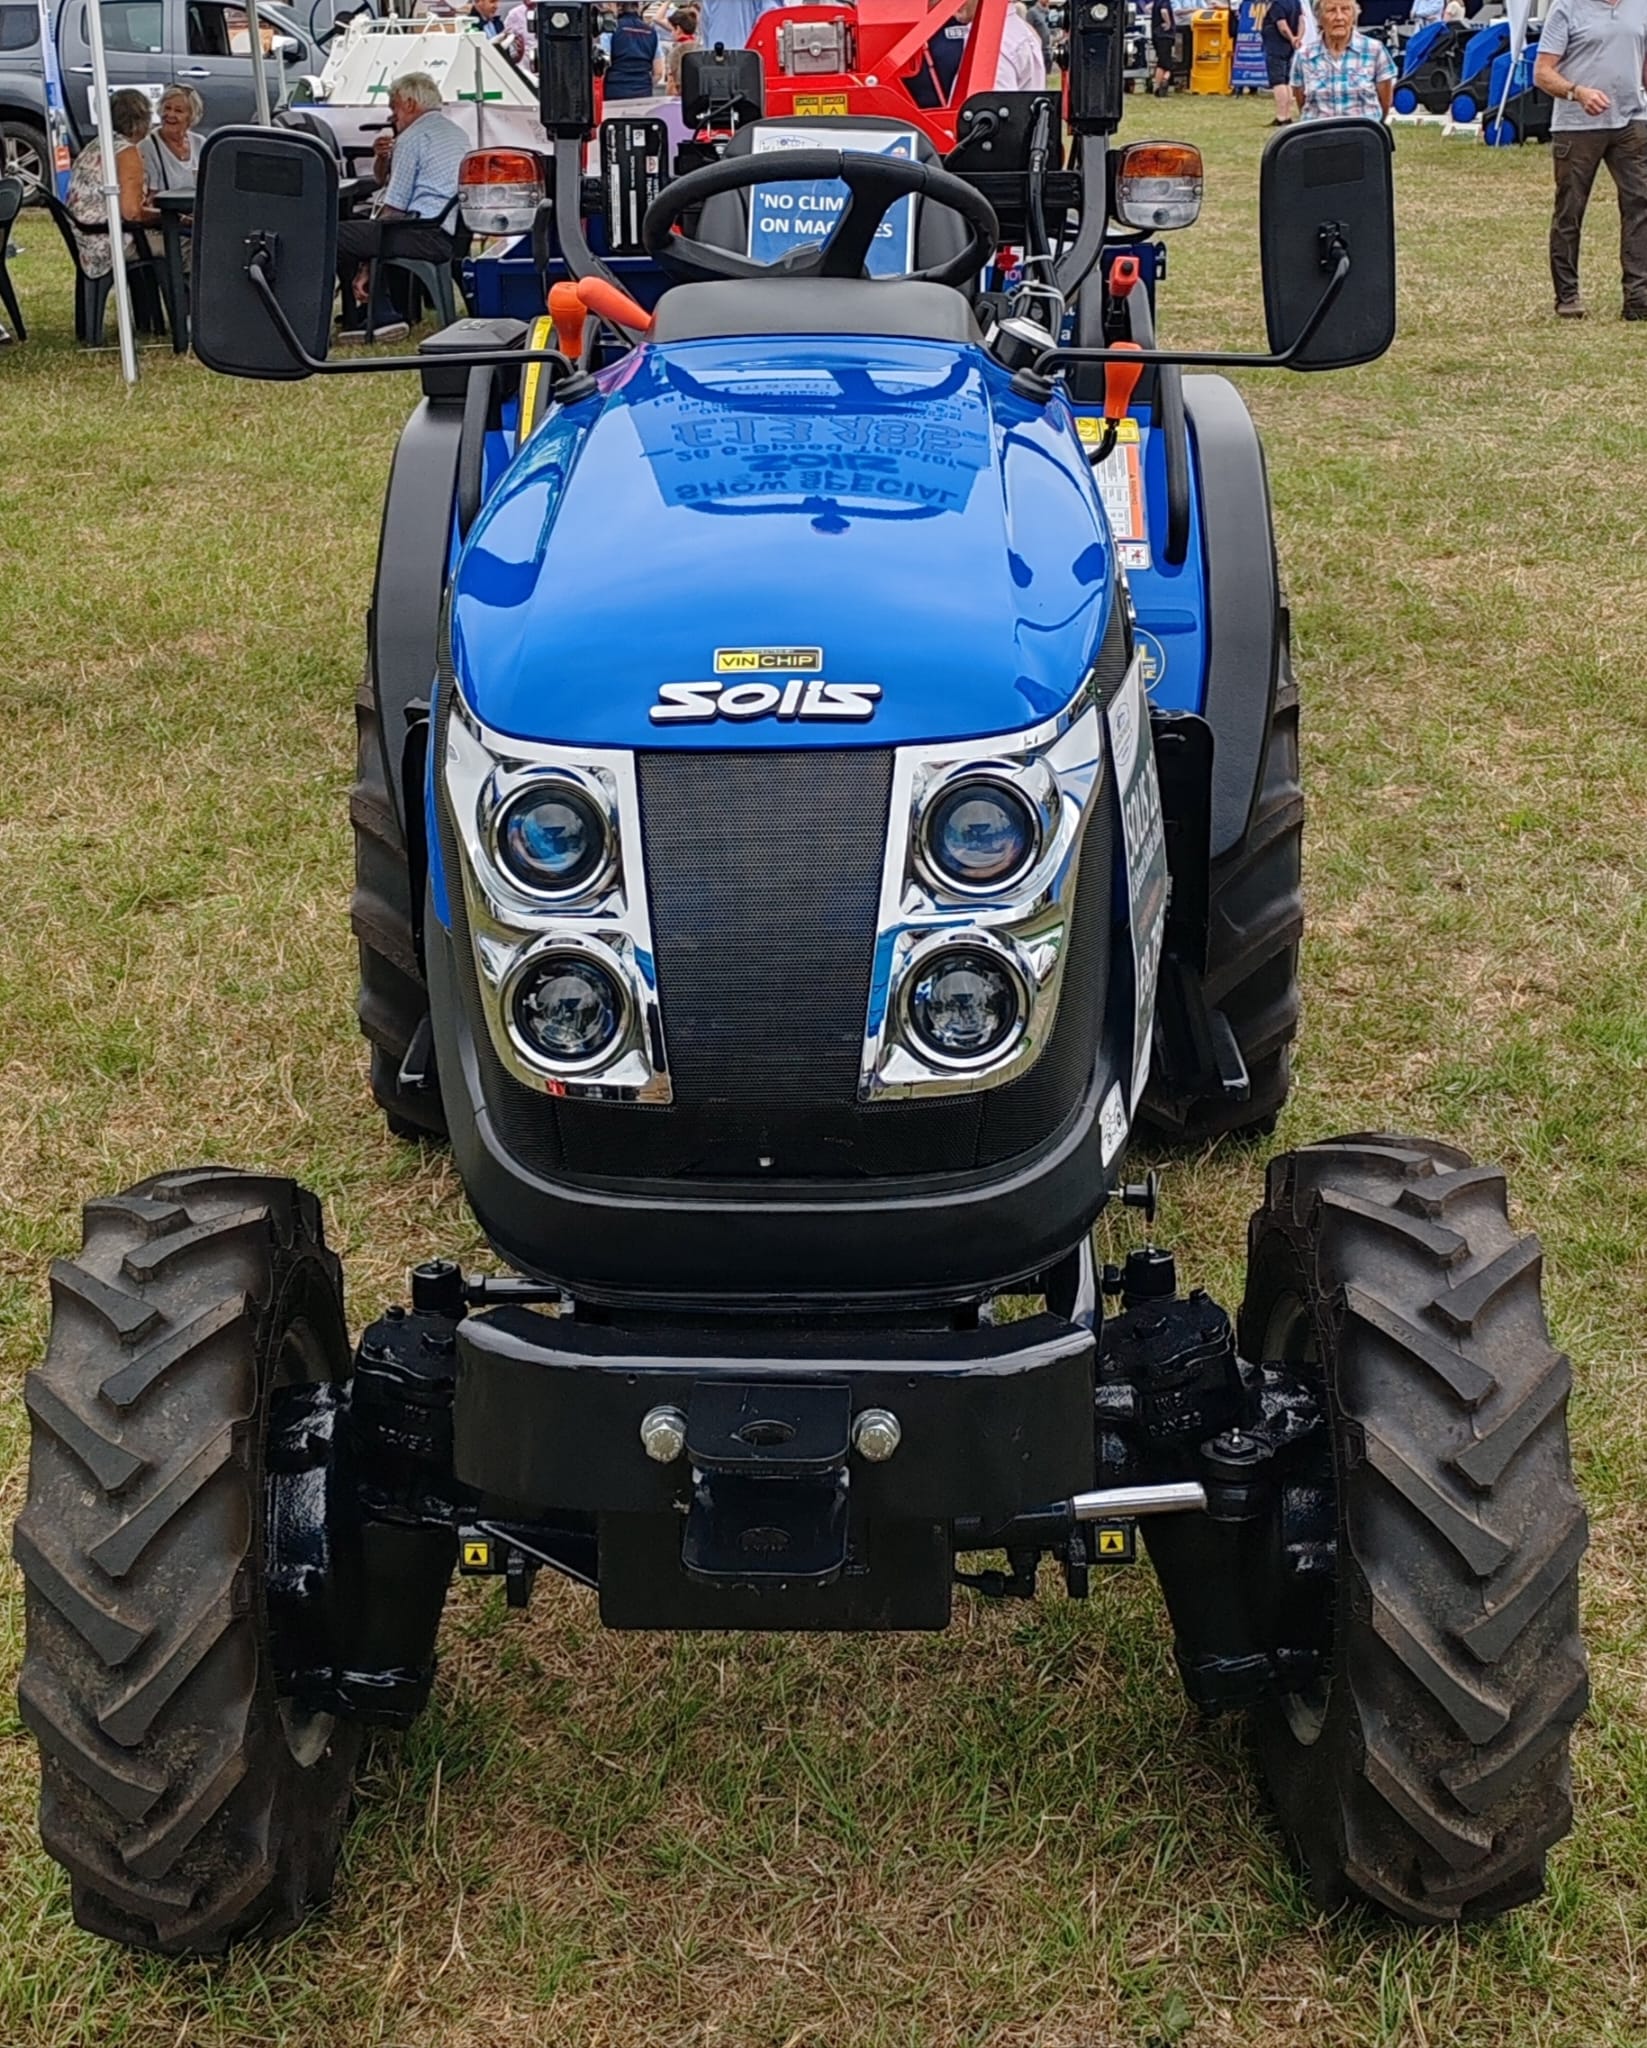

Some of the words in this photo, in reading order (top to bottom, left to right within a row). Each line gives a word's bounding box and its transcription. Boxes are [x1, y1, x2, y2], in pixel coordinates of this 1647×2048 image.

[760, 218, 789, 234] ON
[722, 656, 755, 667] VIN
[760, 655, 813, 667] CHIP
